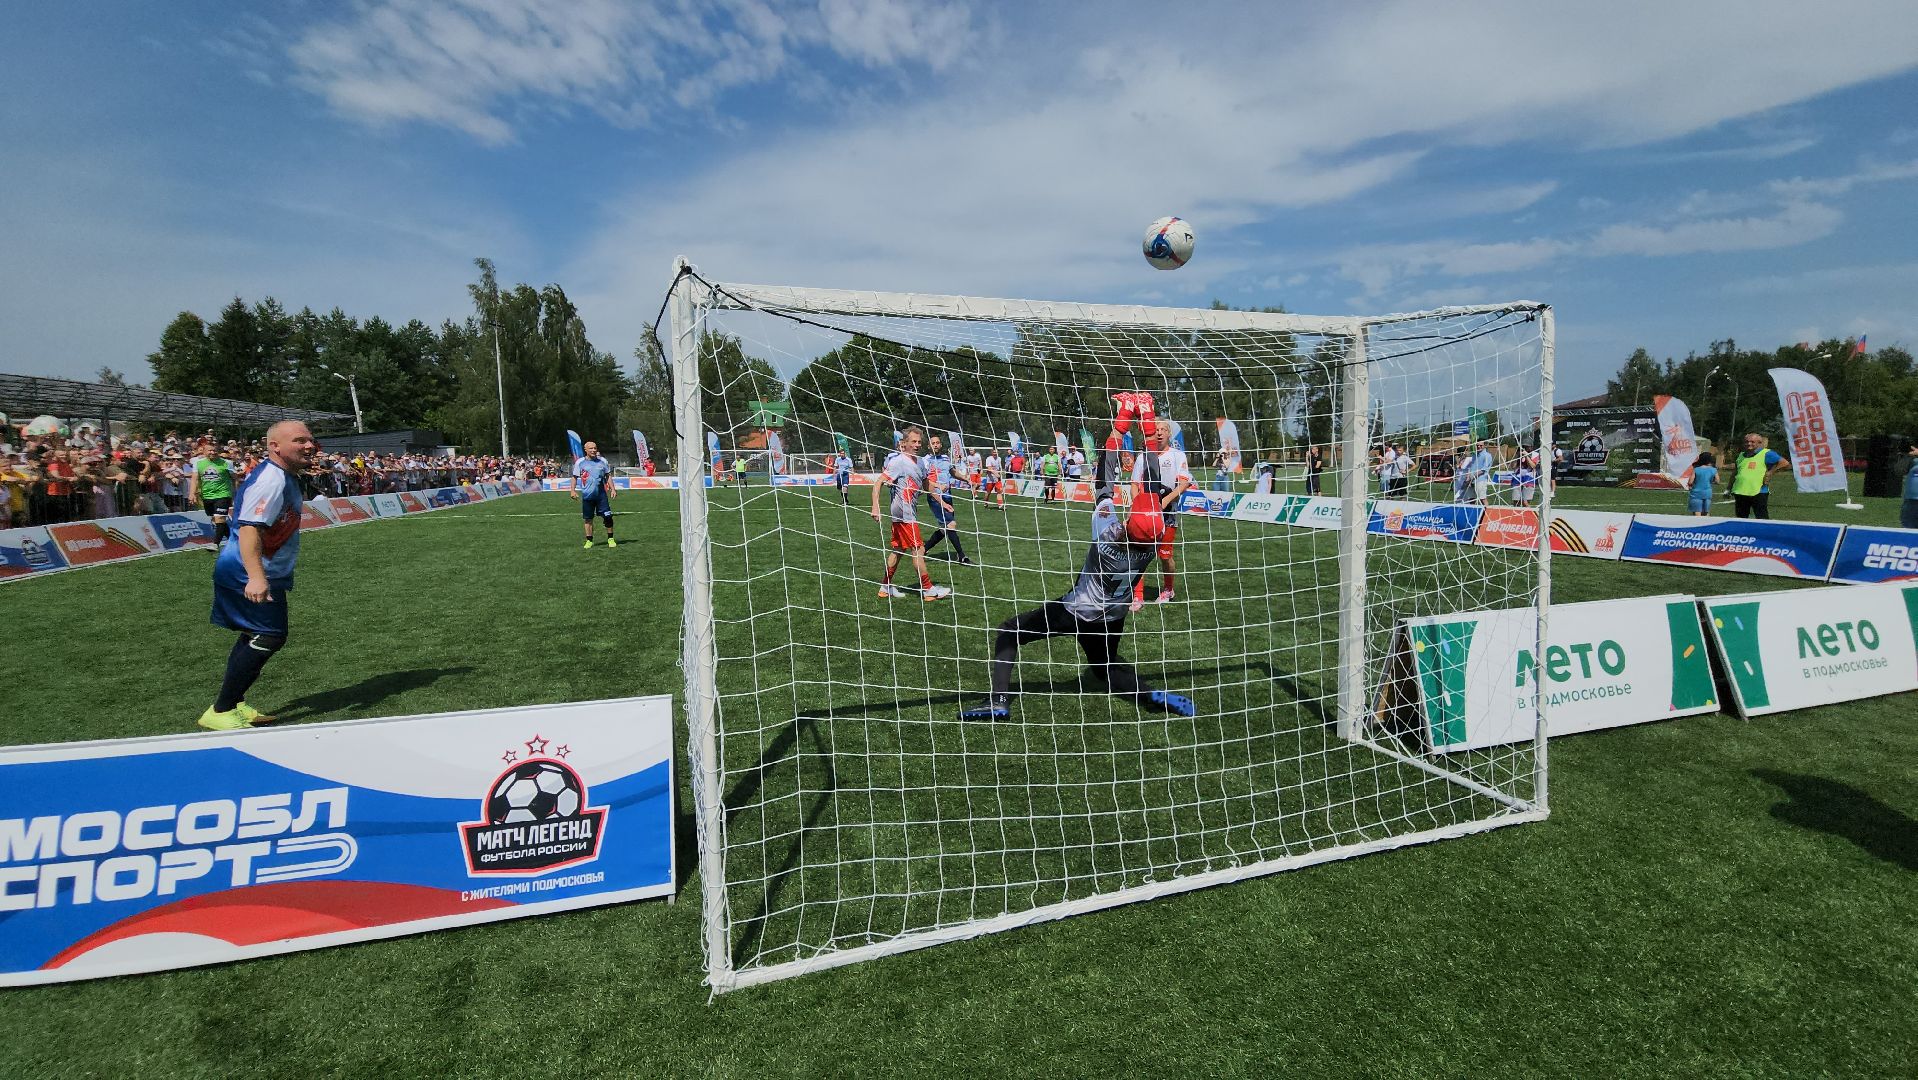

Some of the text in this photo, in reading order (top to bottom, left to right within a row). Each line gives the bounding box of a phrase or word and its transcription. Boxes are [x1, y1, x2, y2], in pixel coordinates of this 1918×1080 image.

[1408, 515, 1444, 524] КОМАНДА
[1655, 530, 1756, 544] #ВЫХОДИВОДВОР
[1652, 539, 1797, 558] #КОМАНДАГУБЕРНАТОРА
[1862, 555, 1918, 573] СПО
[0, 787, 349, 863] МОСОБЛ
[477, 819, 593, 852] МАТЧ ЛЕГЕНД
[480, 841, 588, 863] ФУТБОЛА РОССИИ
[0, 840, 271, 912] СПОРТ
[461, 871, 605, 902] С ЖИТЕЛЯМИ ПОДМОСКОВЬЯ
